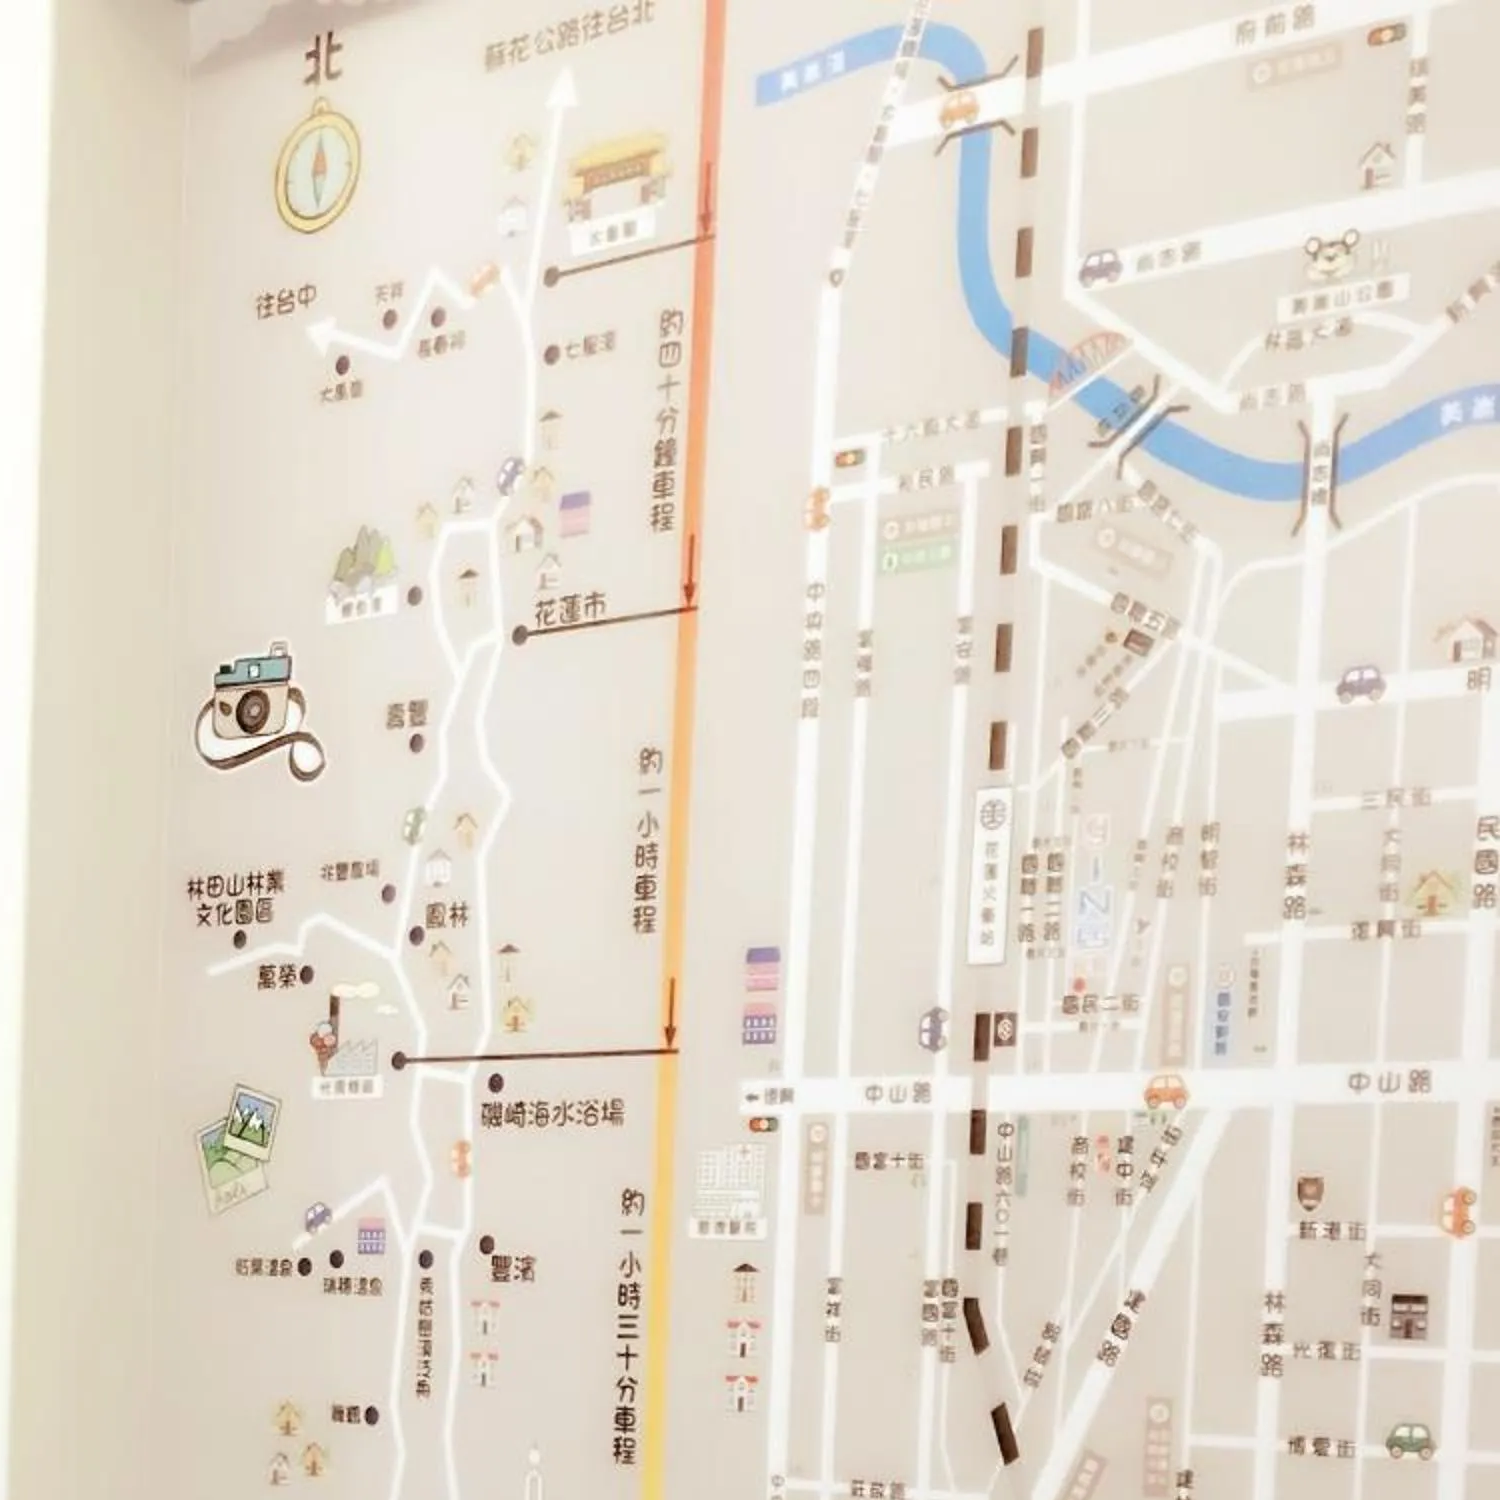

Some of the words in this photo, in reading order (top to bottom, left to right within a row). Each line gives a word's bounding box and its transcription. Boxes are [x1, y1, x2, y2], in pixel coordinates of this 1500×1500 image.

[304, 31, 344, 85] 北
[255, 284, 318, 320] 往台中
[534, 590, 608, 627] 花蓮市
[1283, 832, 1310, 920] 林森路
[865, 1081, 932, 1105] 中山路
[1347, 1067, 1433, 1095] 中山路
[481, 1098, 625, 1128] 磯崎海水浴場
[1261, 1291, 1285, 1377] 林森路
